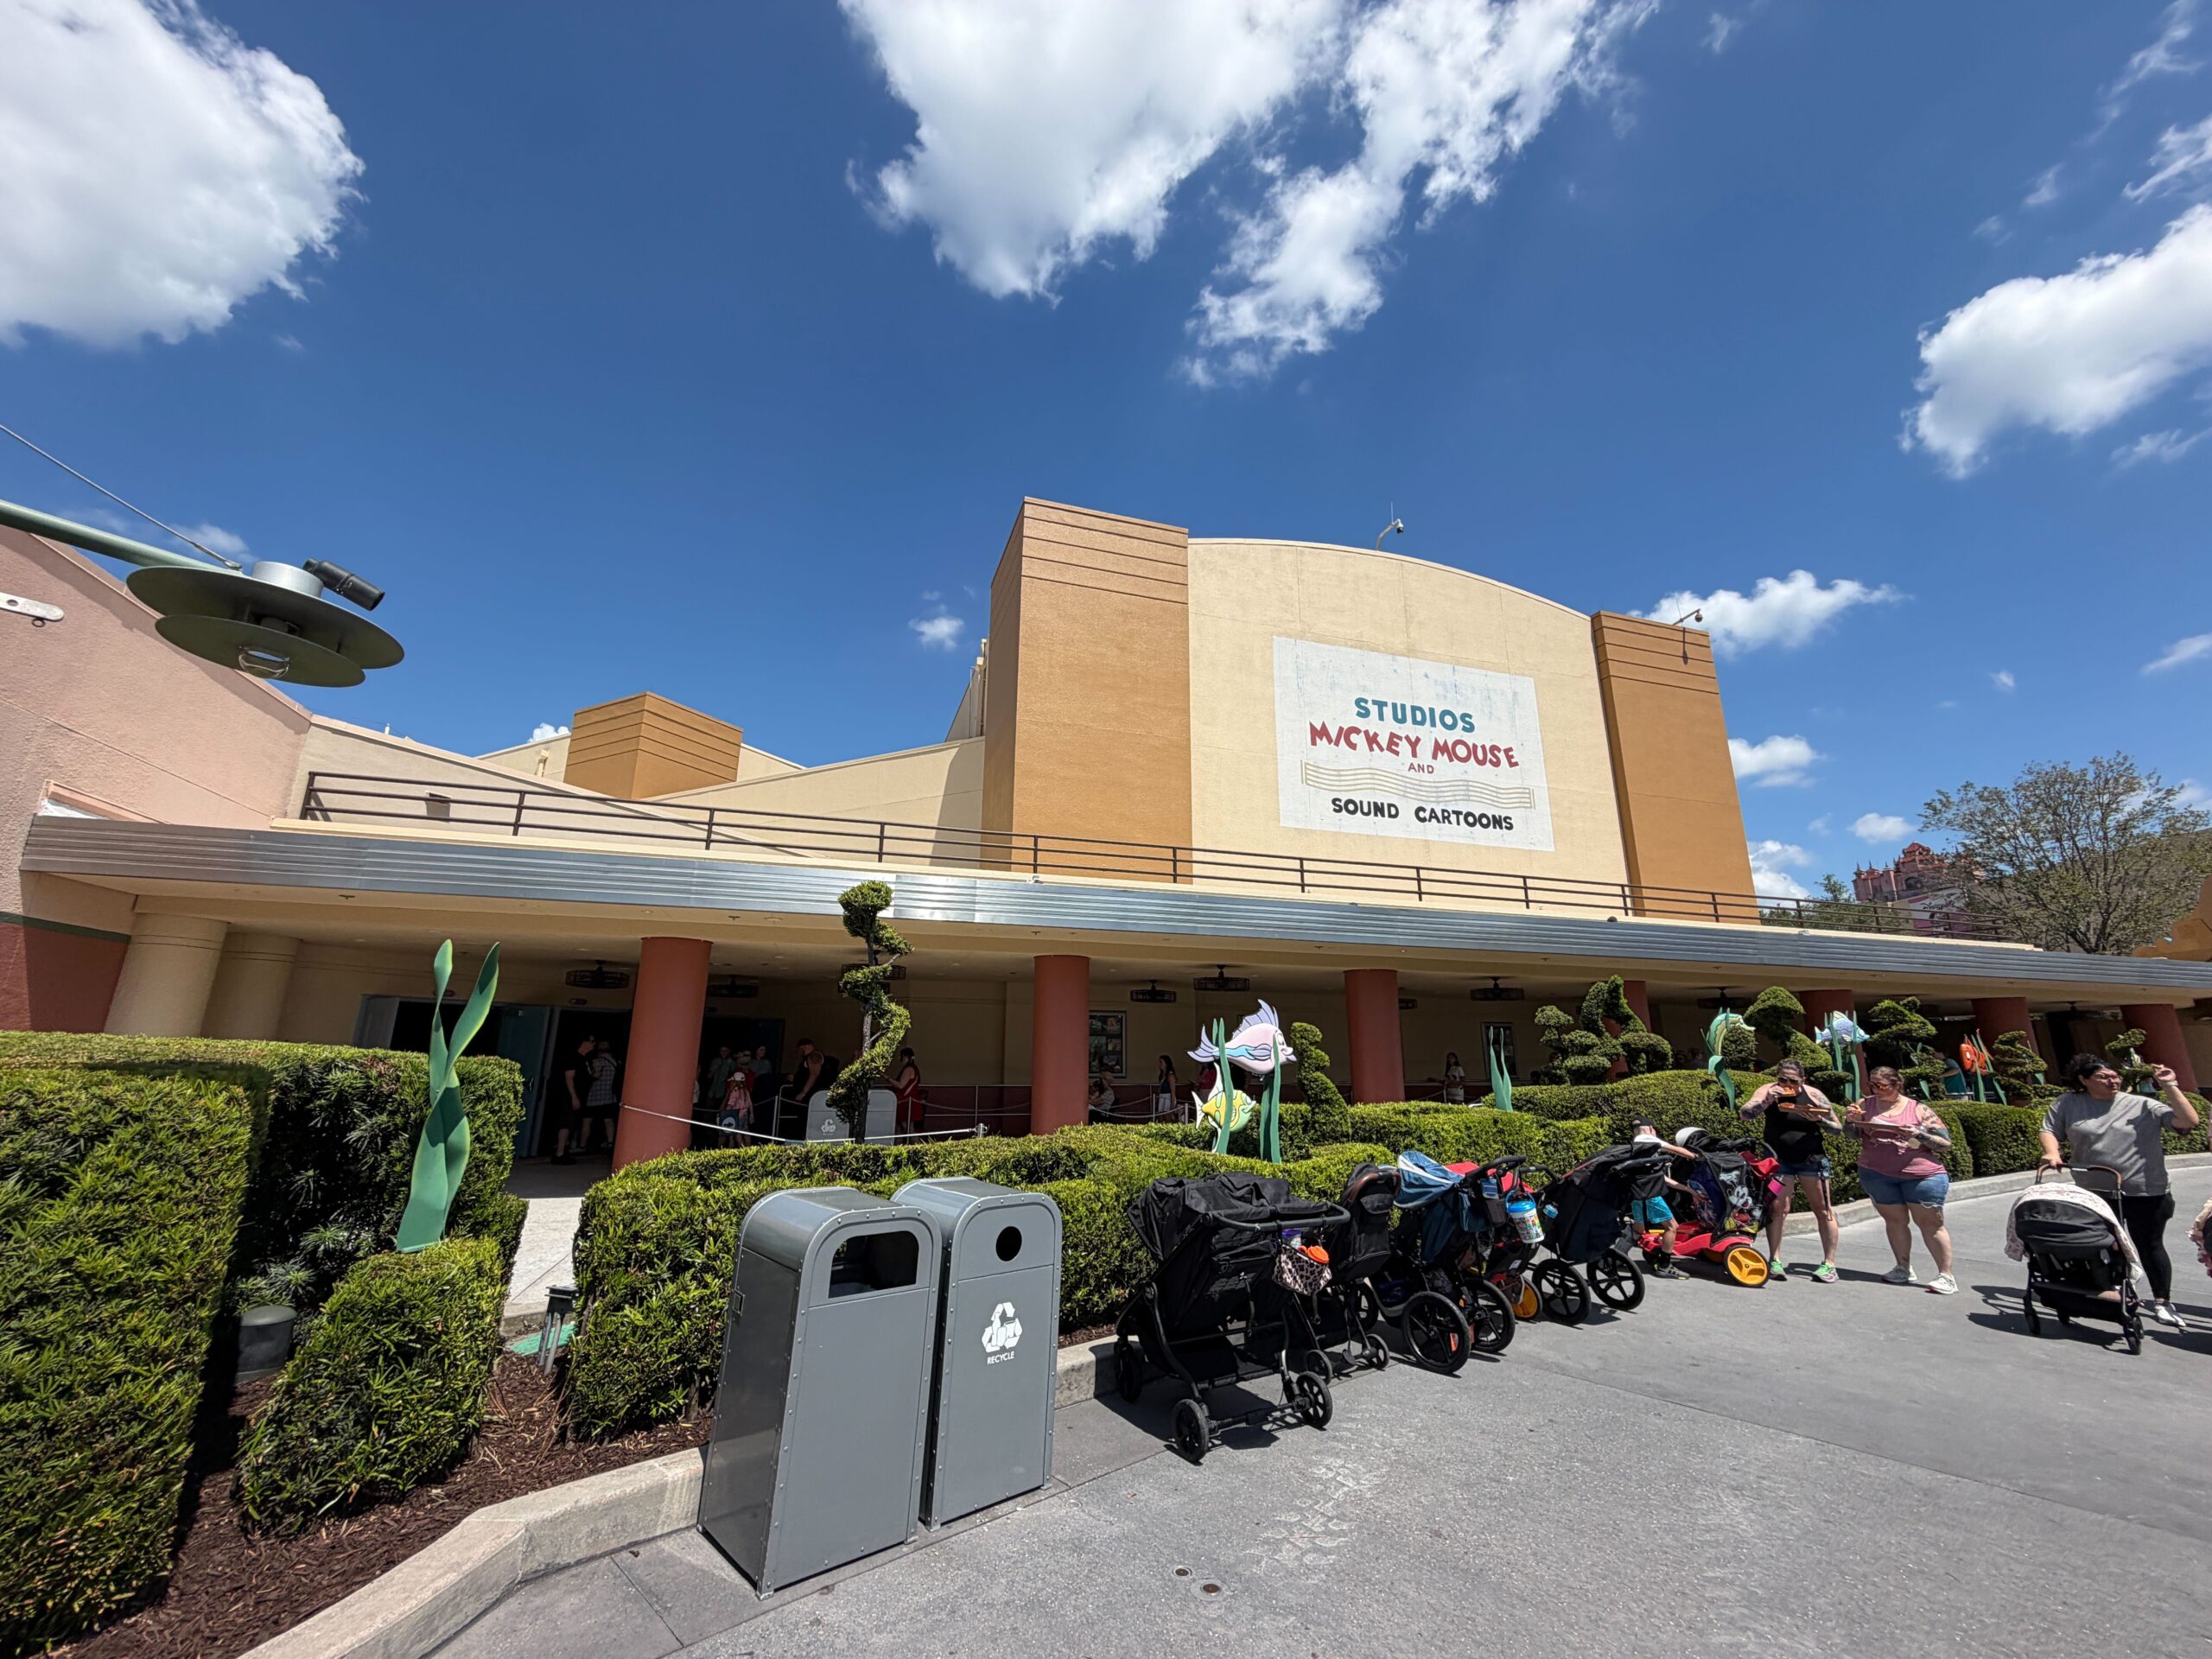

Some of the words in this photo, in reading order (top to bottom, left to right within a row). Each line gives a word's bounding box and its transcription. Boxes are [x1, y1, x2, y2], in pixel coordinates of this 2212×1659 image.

[1354, 696, 1476, 734] STUDIOS
[1308, 720, 1422, 759] MICKEY
[1431, 738, 1520, 768] MOUSE
[1408, 761, 1435, 775] AND
[1331, 797, 1400, 820] SOUND
[1414, 805, 1515, 831] CARTOONS
[987, 1351, 1015, 1365] RECYCLE
